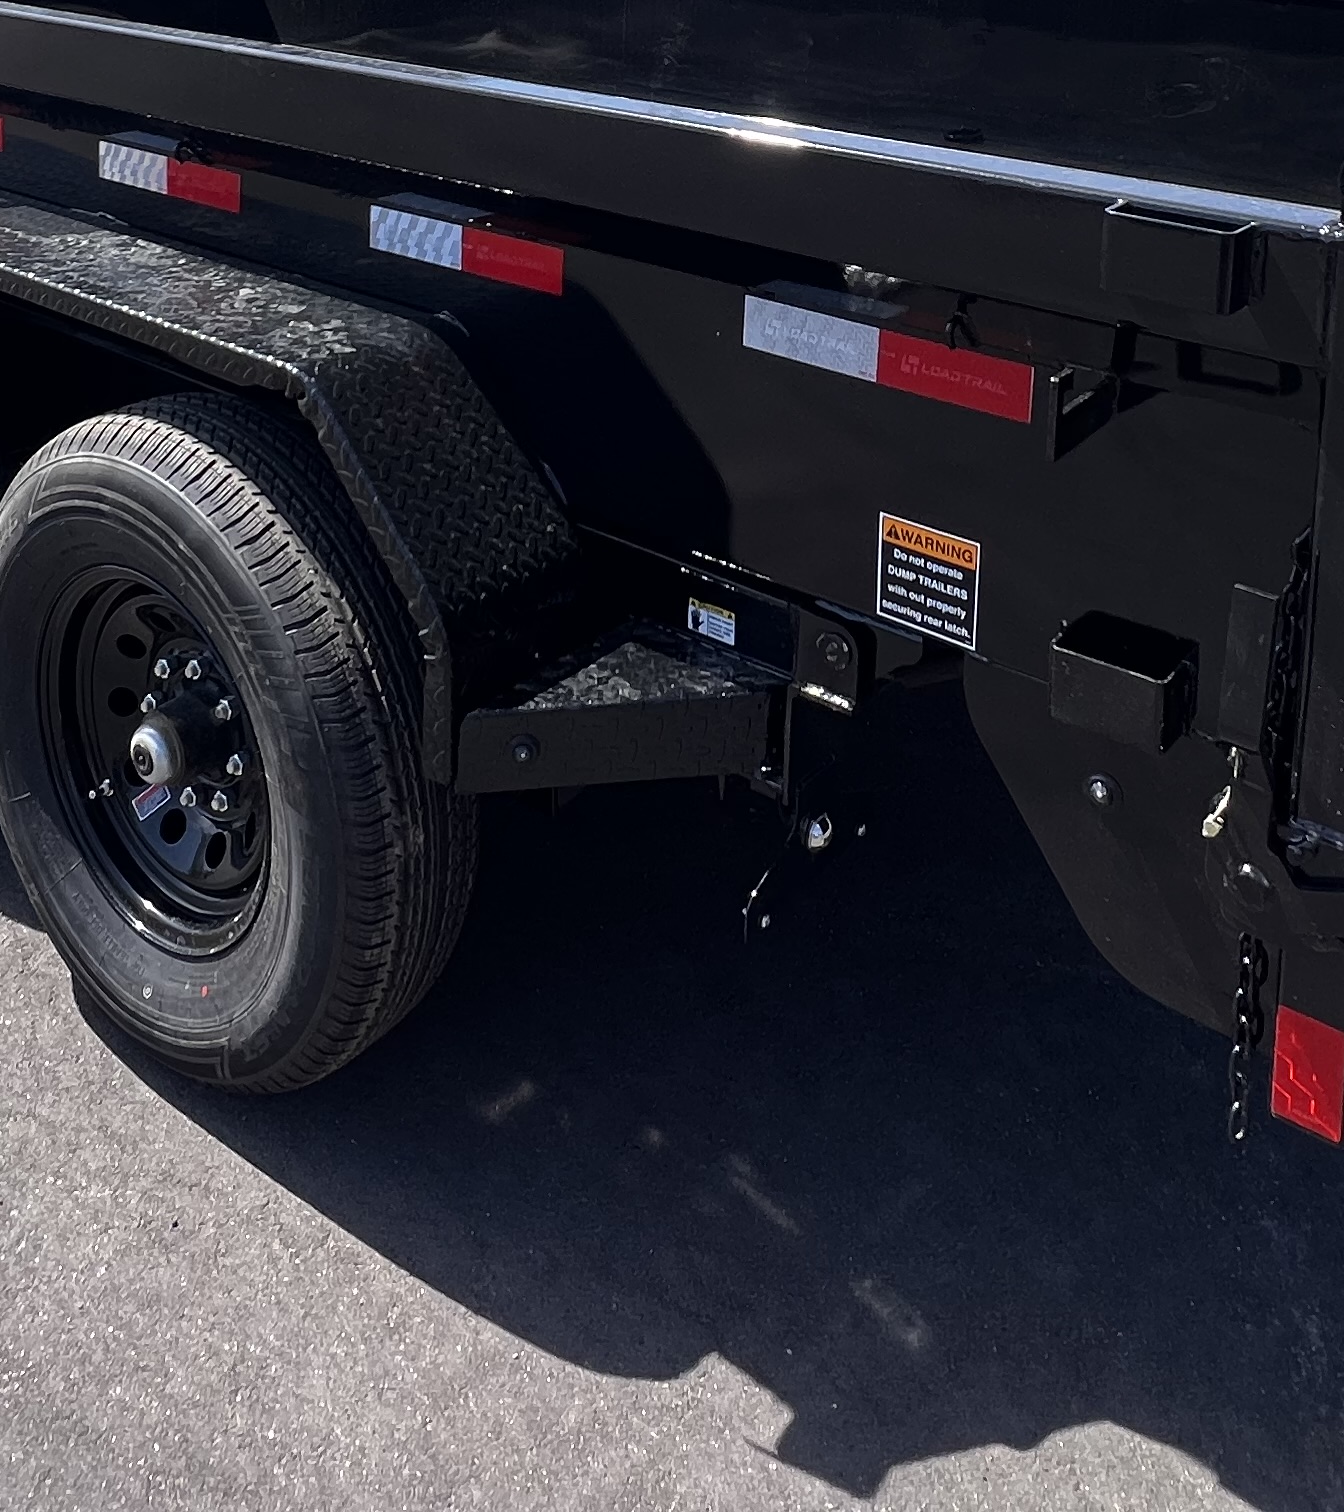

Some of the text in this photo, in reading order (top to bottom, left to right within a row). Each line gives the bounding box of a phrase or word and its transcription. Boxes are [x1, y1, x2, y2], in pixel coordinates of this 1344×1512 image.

[900, 528, 973, 564] WARNING
[887, 564, 968, 600] DUMP TRAILERS
[893, 548, 964, 581] Do not operate
[882, 599, 922, 622] securing
[923, 614, 943, 628] rear
[887, 583, 967, 620] with out properly
